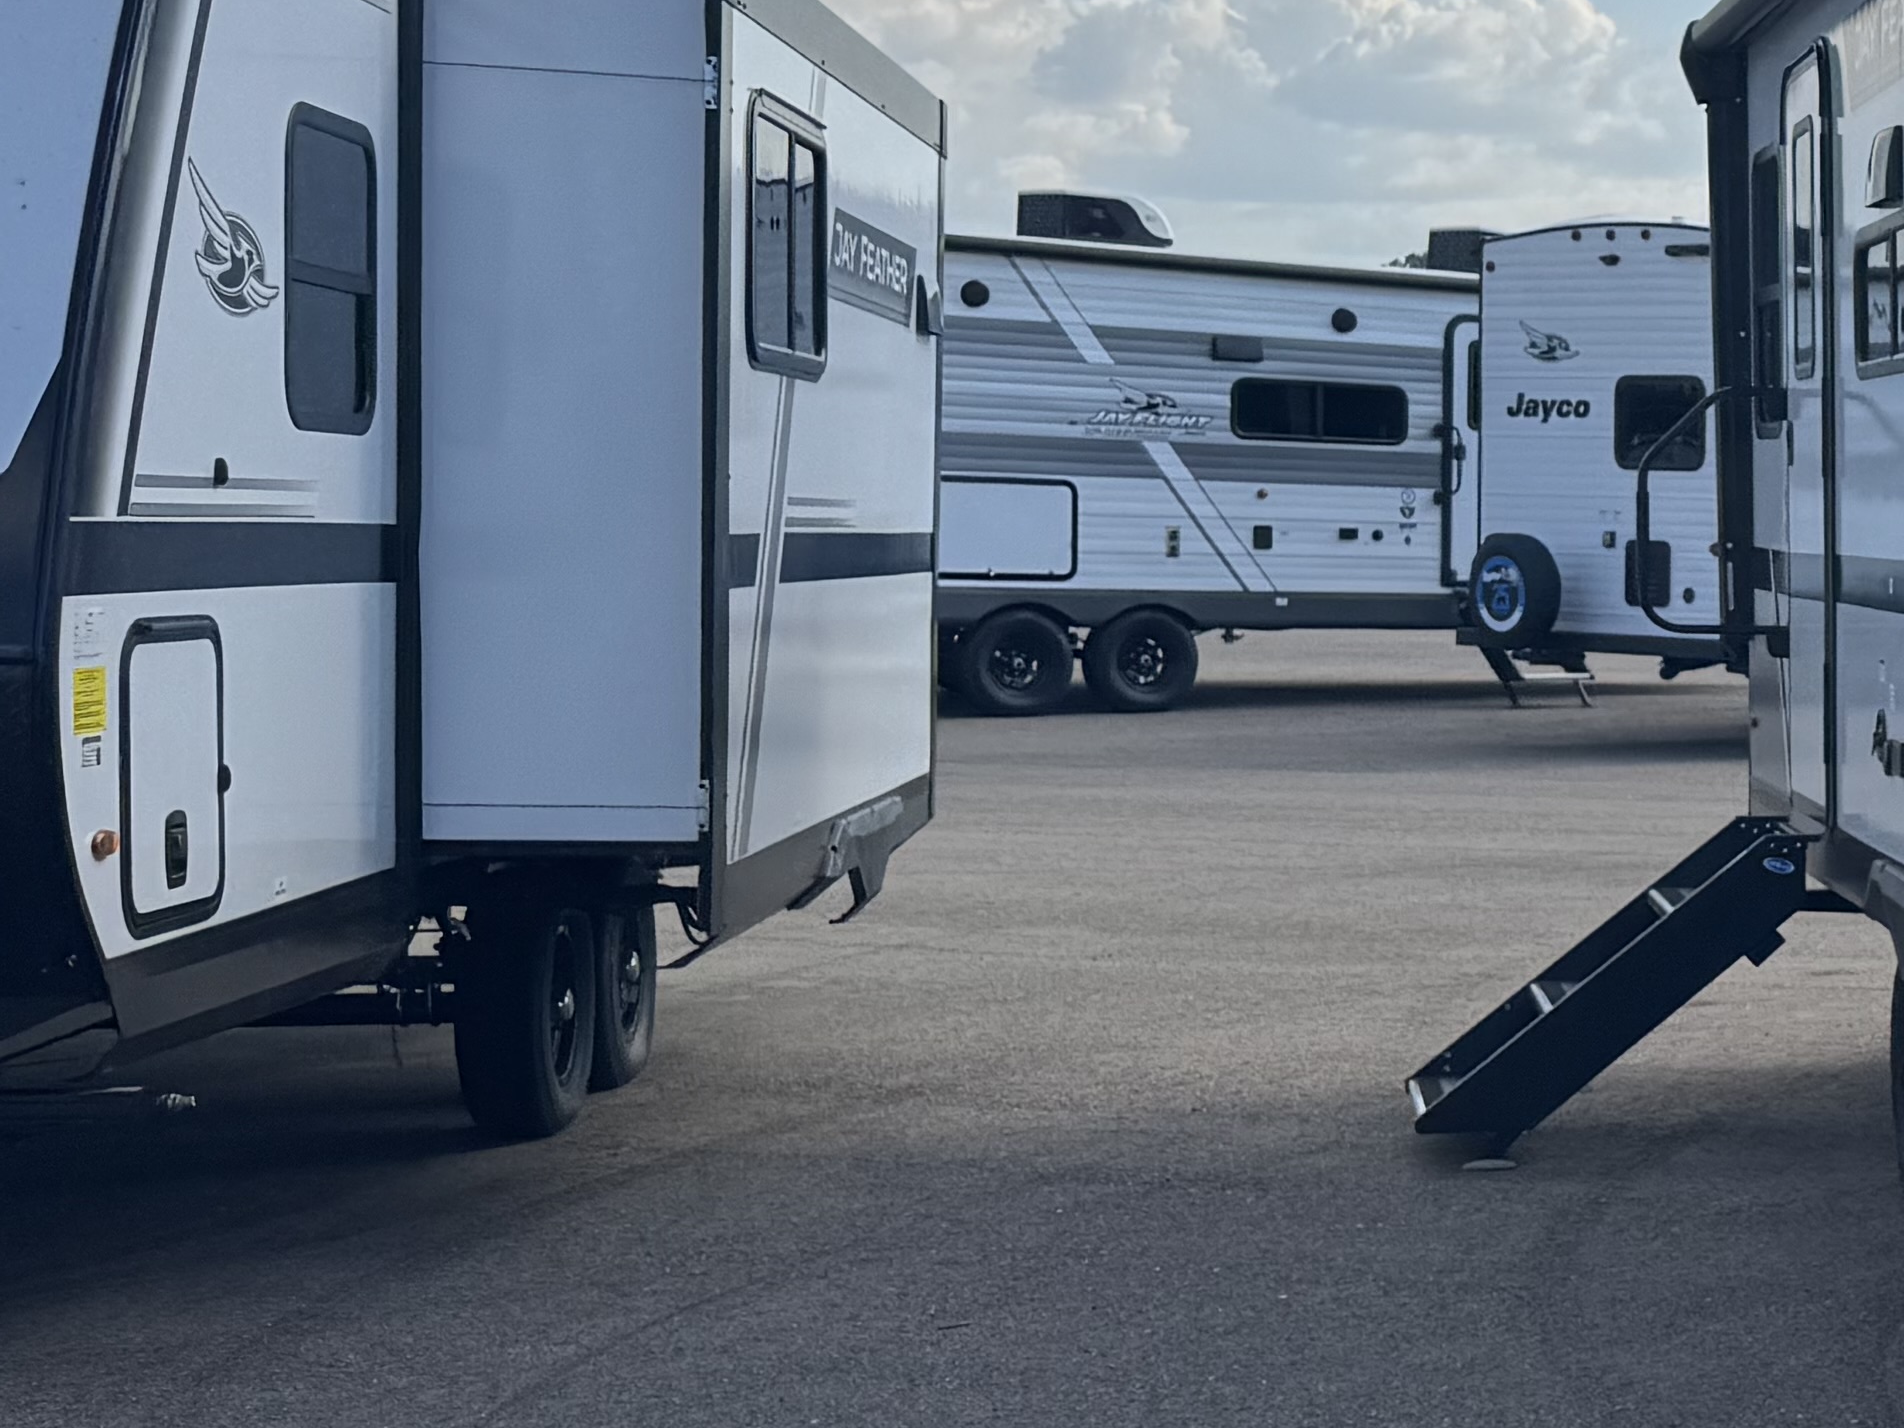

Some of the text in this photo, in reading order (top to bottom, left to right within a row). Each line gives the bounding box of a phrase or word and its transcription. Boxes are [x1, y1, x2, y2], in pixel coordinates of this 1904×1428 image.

[833, 221, 908, 296] JAY FEATHER
[1506, 392, 1591, 424] Jayco
